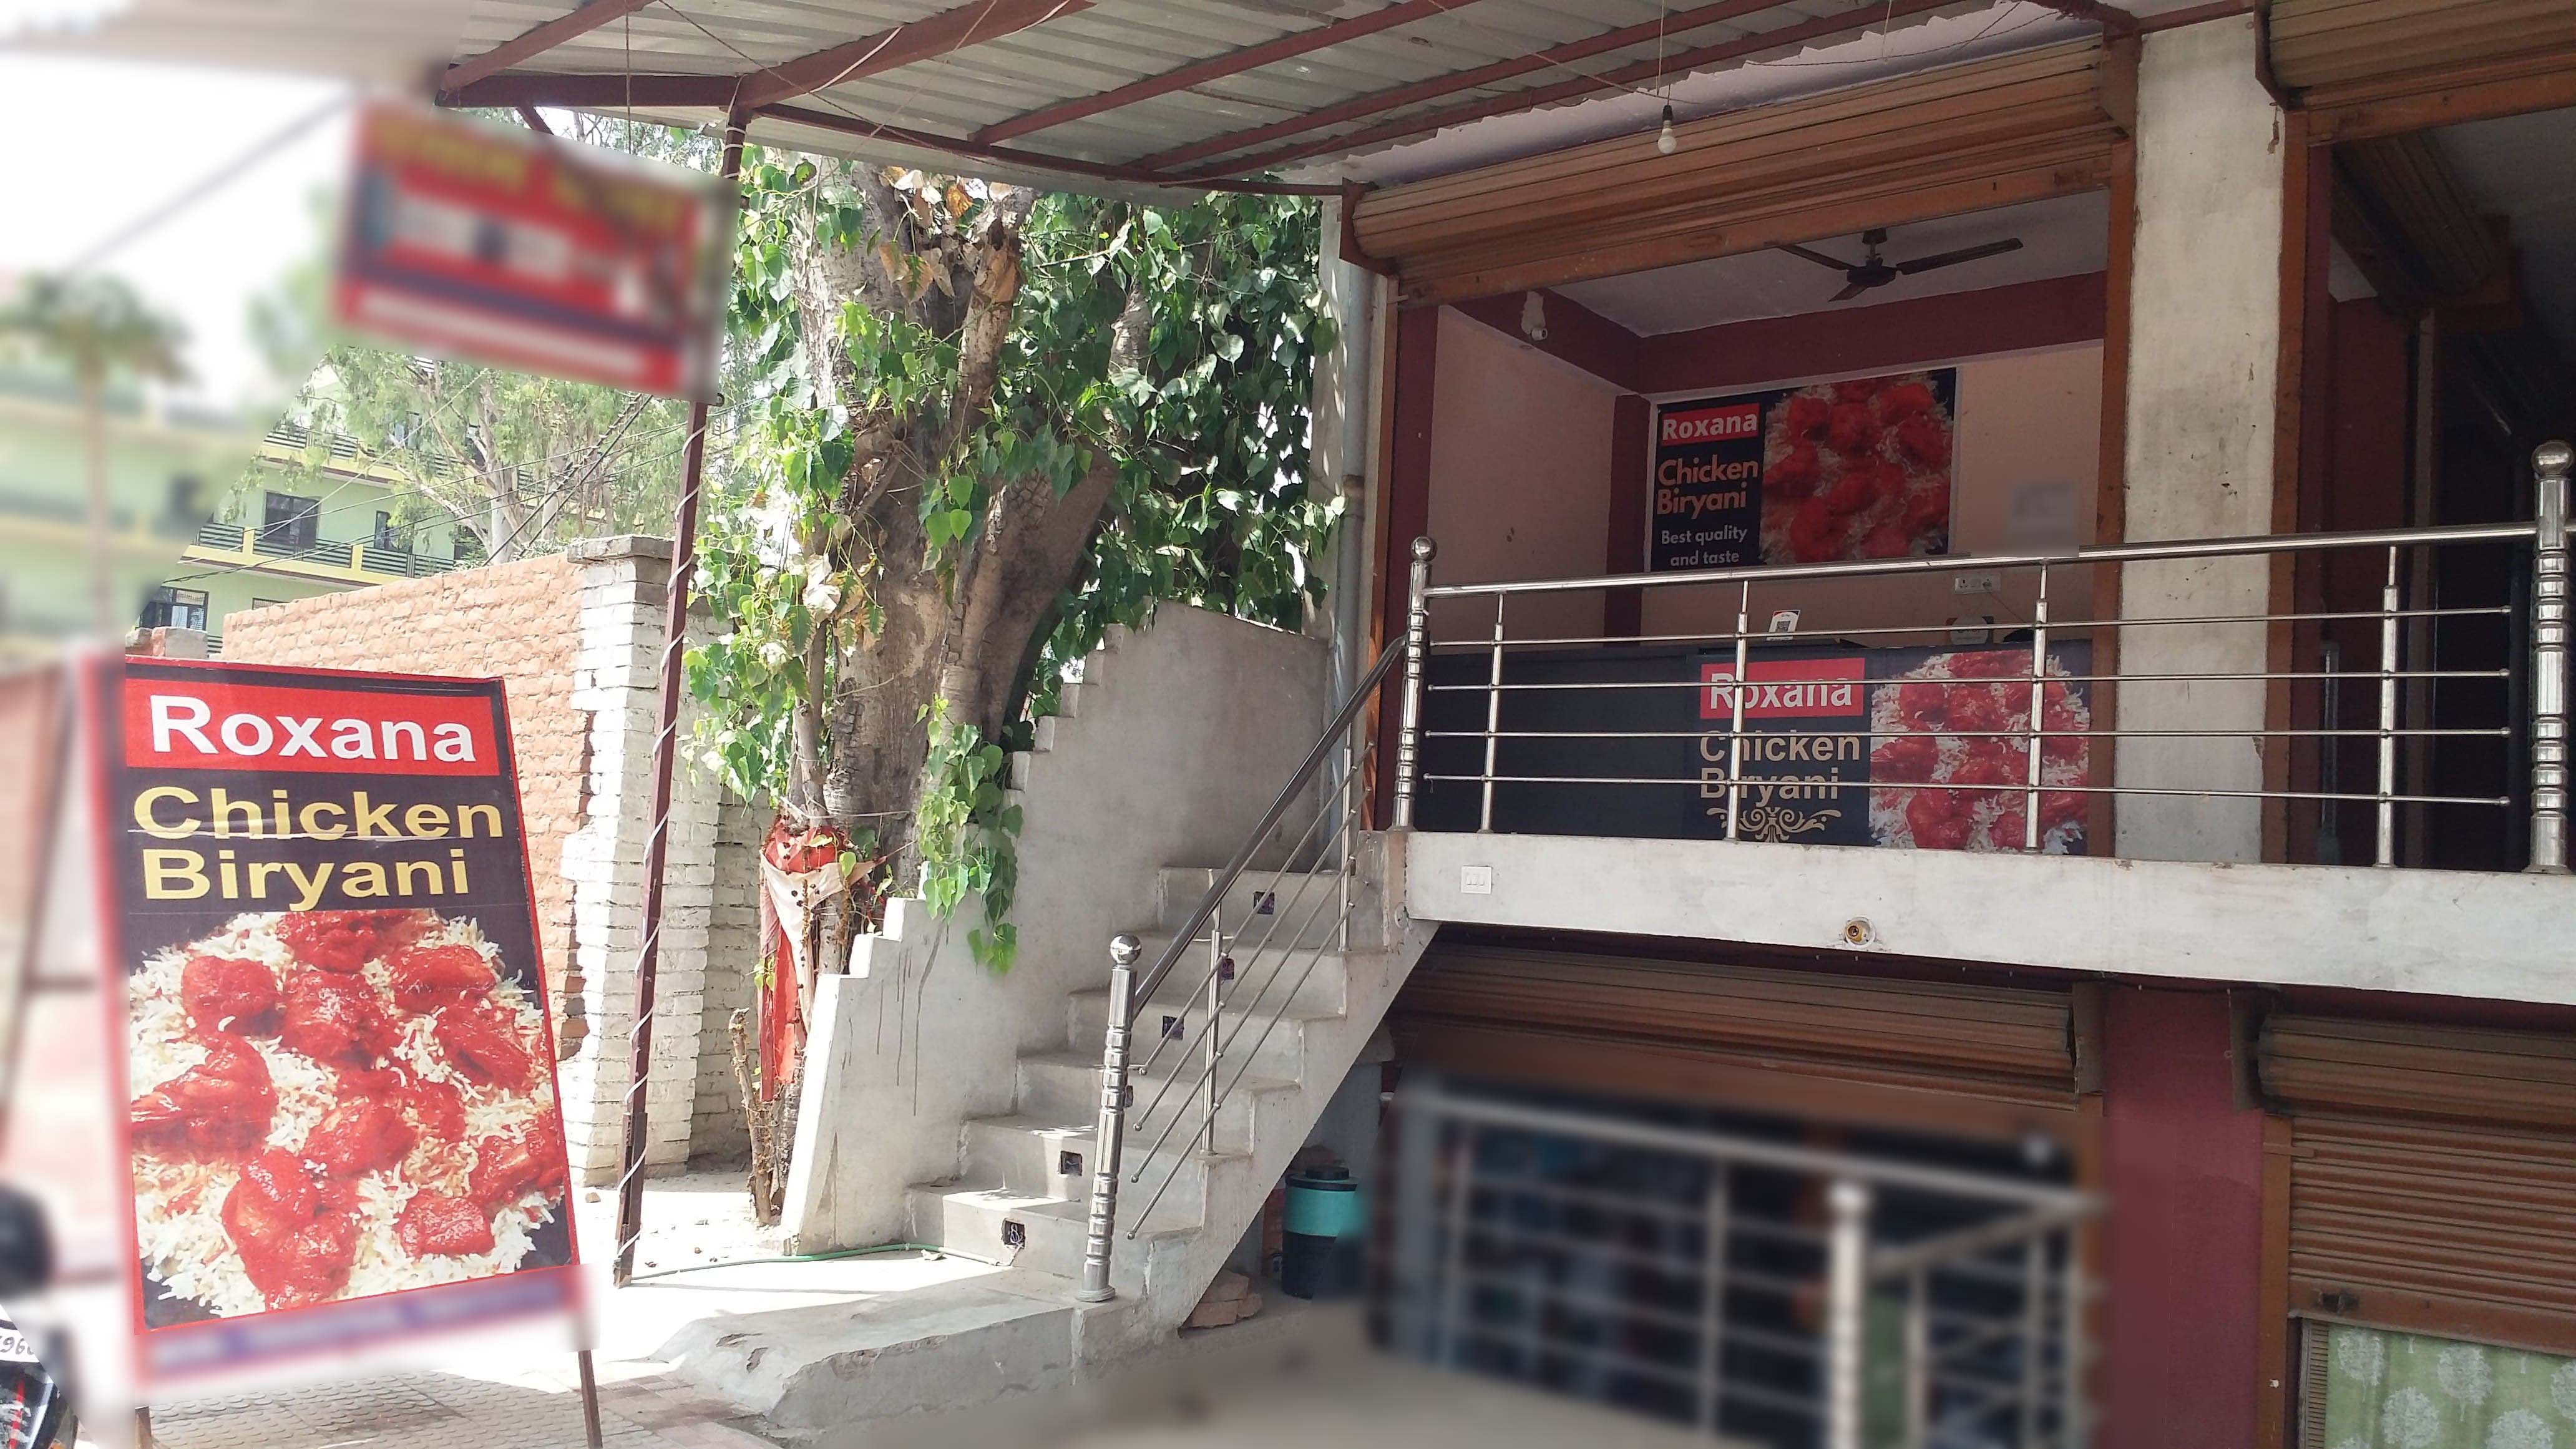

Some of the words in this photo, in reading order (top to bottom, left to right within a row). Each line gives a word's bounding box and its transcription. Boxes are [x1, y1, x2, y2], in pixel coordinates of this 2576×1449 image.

[1662, 414, 1757, 440] Roxana
[1658, 454, 1758, 485] Chicken
[1657, 483, 1747, 520] Biryani
[1661, 530, 1692, 545] Best
[1695, 525, 1747, 545] quality
[1670, 550, 1699, 567] and
[1702, 551, 1739, 564] taste
[1710, 673, 1852, 709] Roxana
[150, 694, 476, 763] Roxana
[1700, 767, 1838, 807] Bryani
[134, 786, 504, 839] Chicken
[142, 848, 470, 912] Biryani
